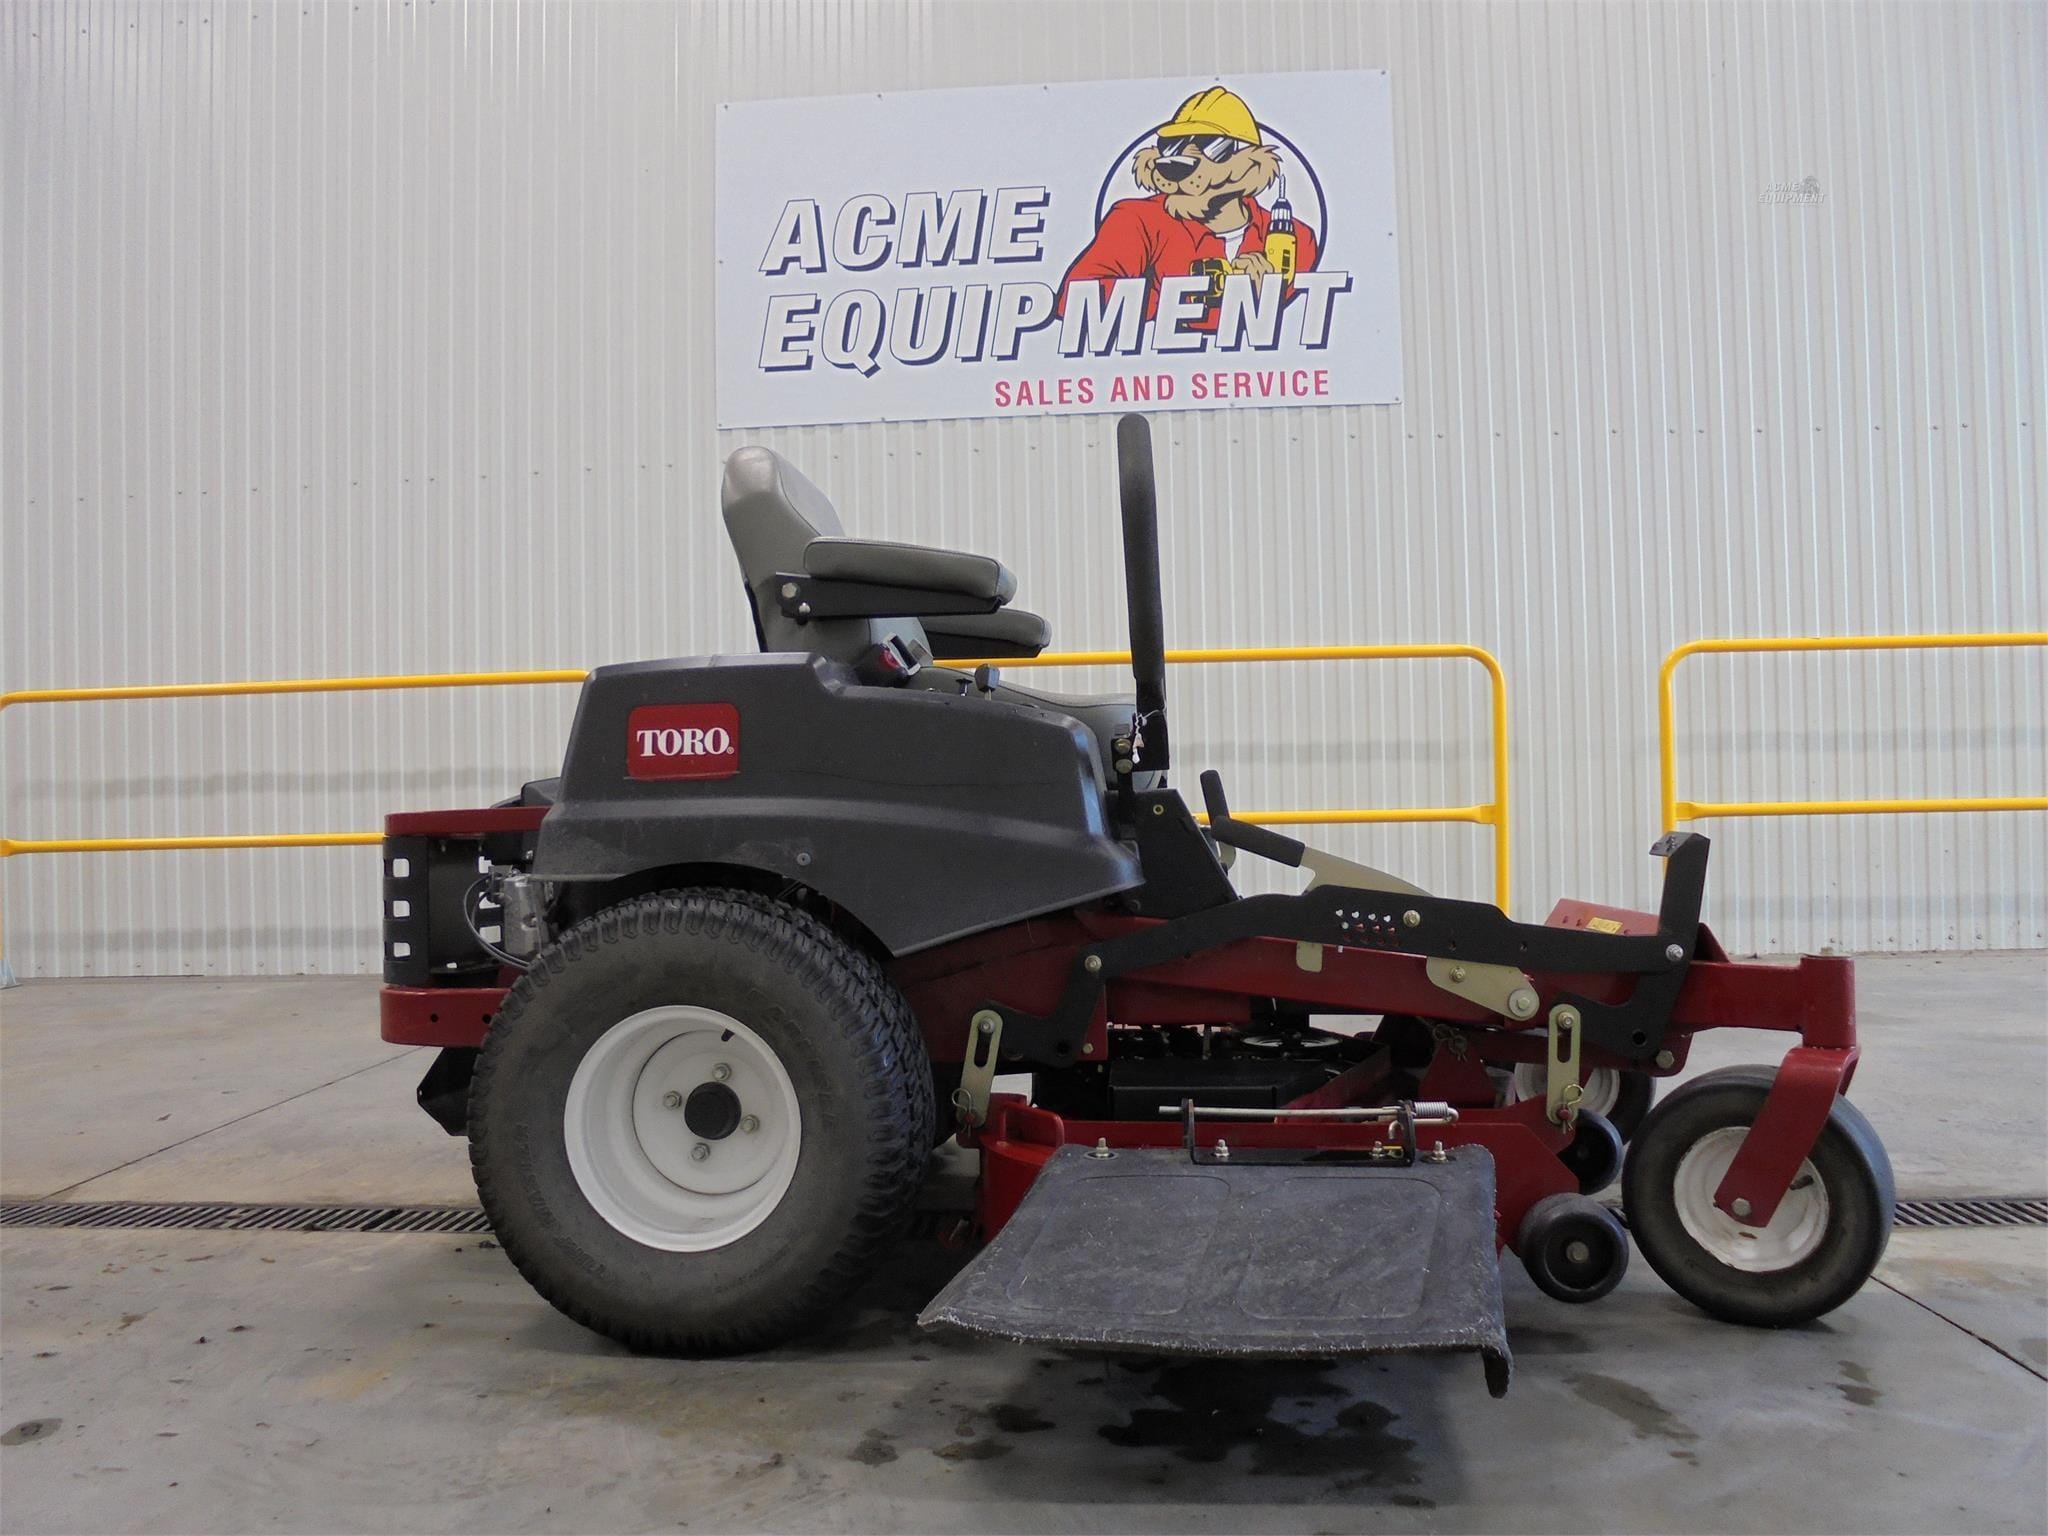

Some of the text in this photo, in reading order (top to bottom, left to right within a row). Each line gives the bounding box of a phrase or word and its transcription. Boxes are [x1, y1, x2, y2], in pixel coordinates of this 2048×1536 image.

[760, 187, 1050, 276] ACME
[759, 271, 1353, 378] EQUIPMENT
[995, 371, 1329, 408] SALES AND SERVICE
